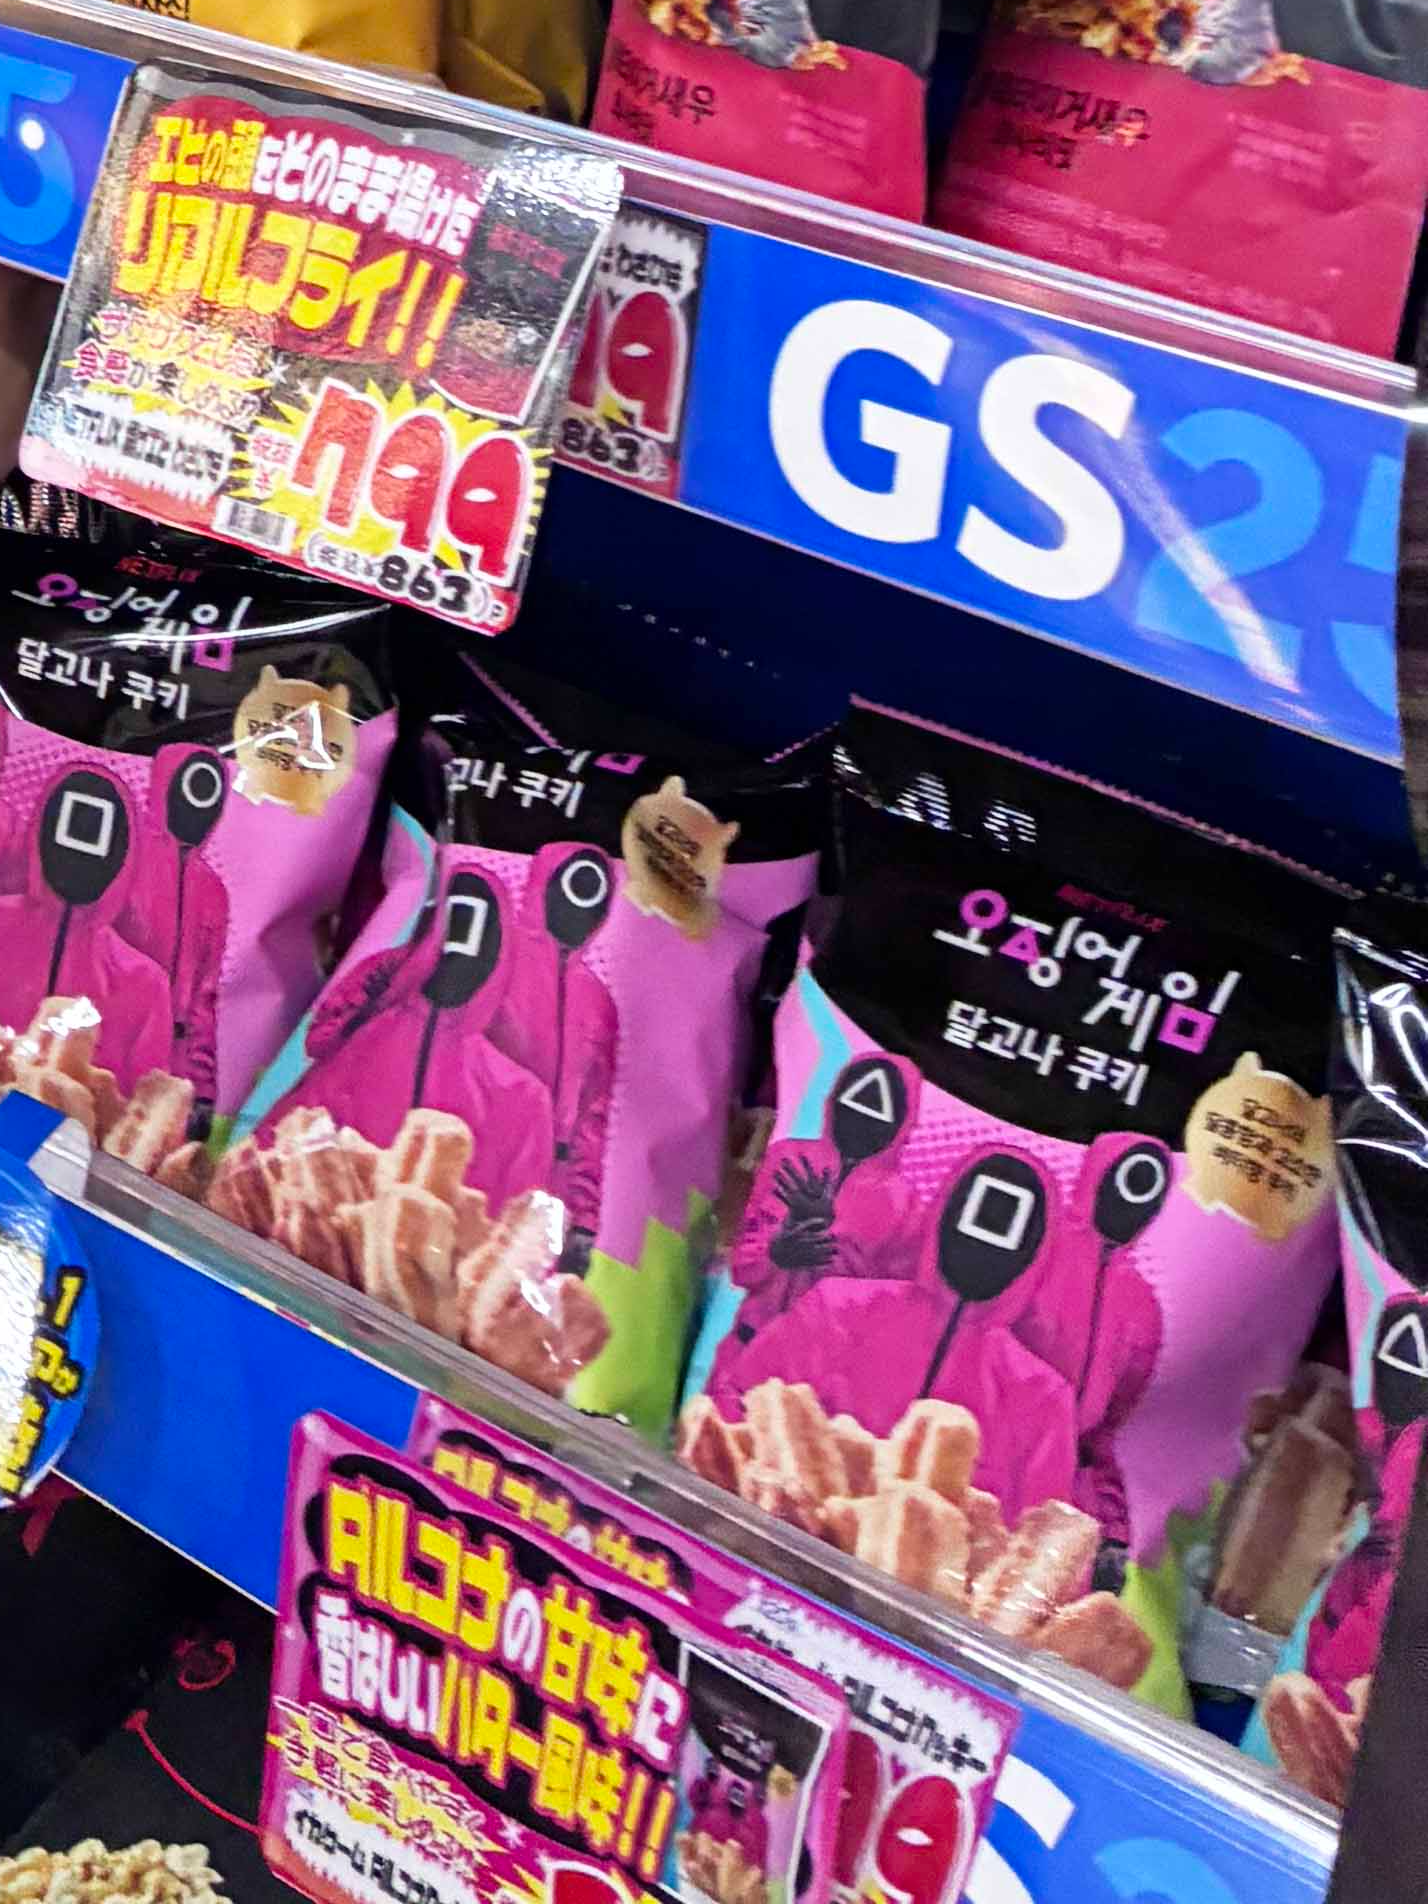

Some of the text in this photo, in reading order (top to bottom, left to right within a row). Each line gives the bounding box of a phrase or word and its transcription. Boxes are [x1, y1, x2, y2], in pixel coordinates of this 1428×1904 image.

[150, 114, 483, 258] エビの頭をそのまま揚げた
[10, 572, 180, 624] 오징어
[16, 635, 190, 721] 달고나 쿠키
[443, 756, 585, 820] 고나 쿠키
[932, 888, 1142, 989] 오징어
[942, 999, 1151, 1108] 달고나 쿠키
[1082, 969, 1244, 1055] 게임
